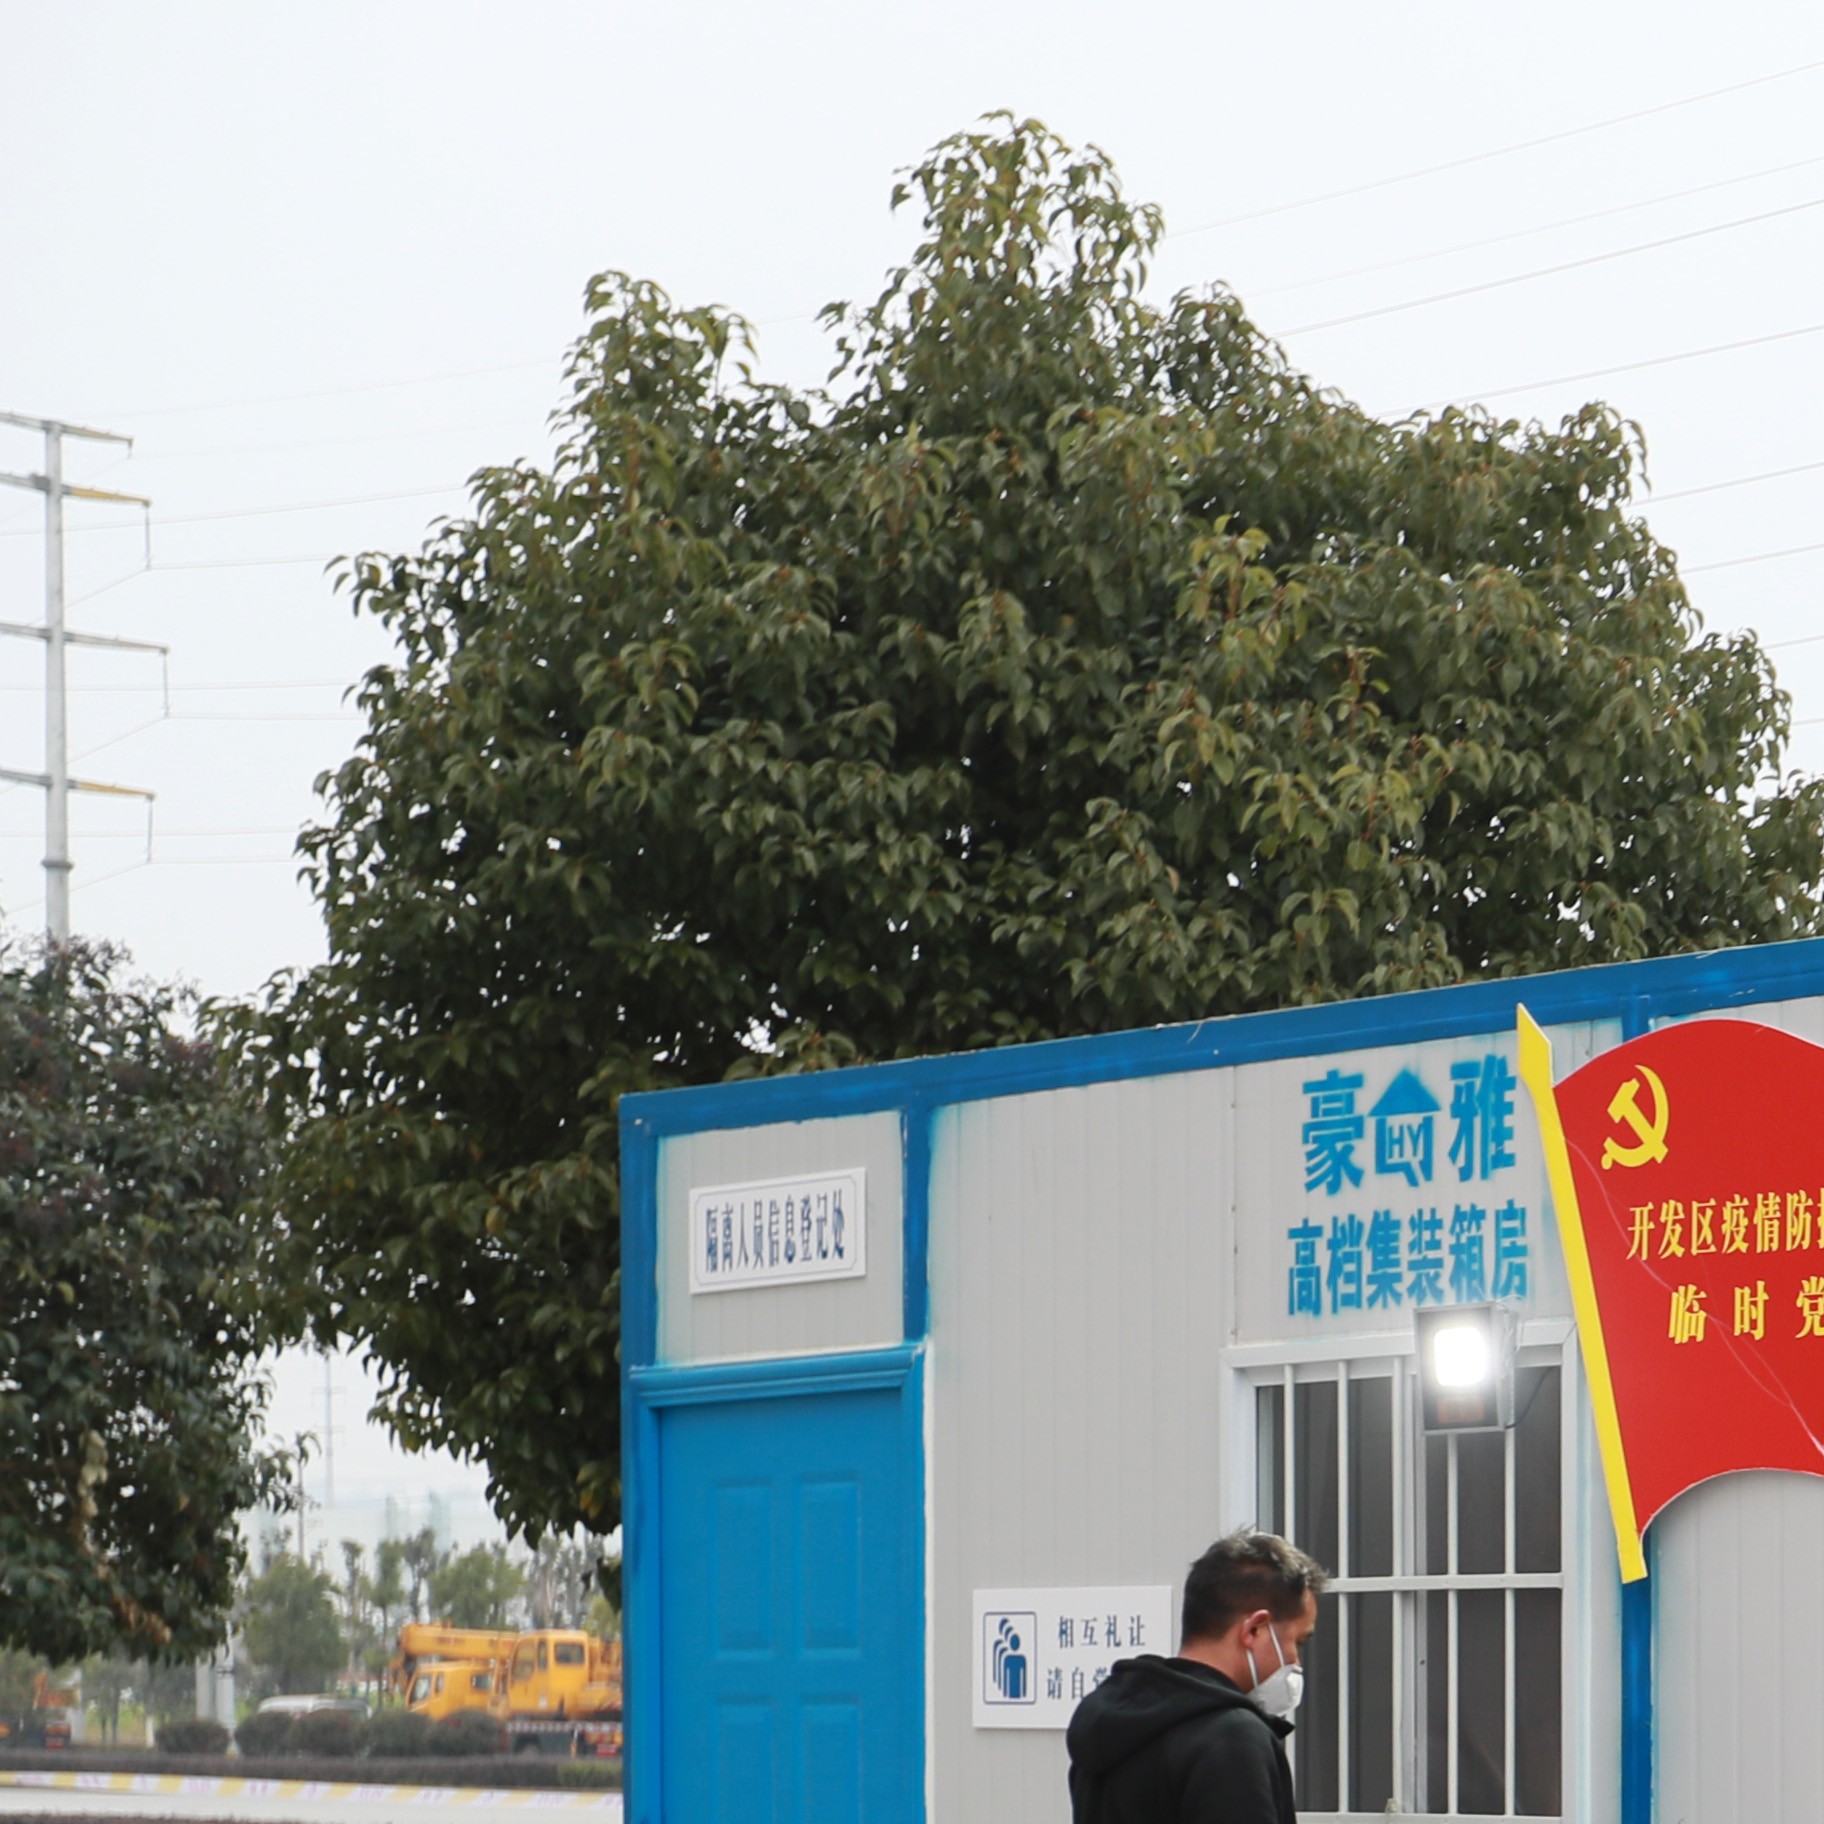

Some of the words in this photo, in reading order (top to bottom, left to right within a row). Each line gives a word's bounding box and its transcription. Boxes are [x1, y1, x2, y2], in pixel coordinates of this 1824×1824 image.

[1302, 1068, 1365, 1196] 豪
[1448, 1054, 1518, 1182] 雅
[705, 1188, 845, 1274] 隔离人员信息登记处
[1287, 1199, 1529, 1318] 高档集装箱房
[1057, 1614, 1147, 1649] 相互礼让
